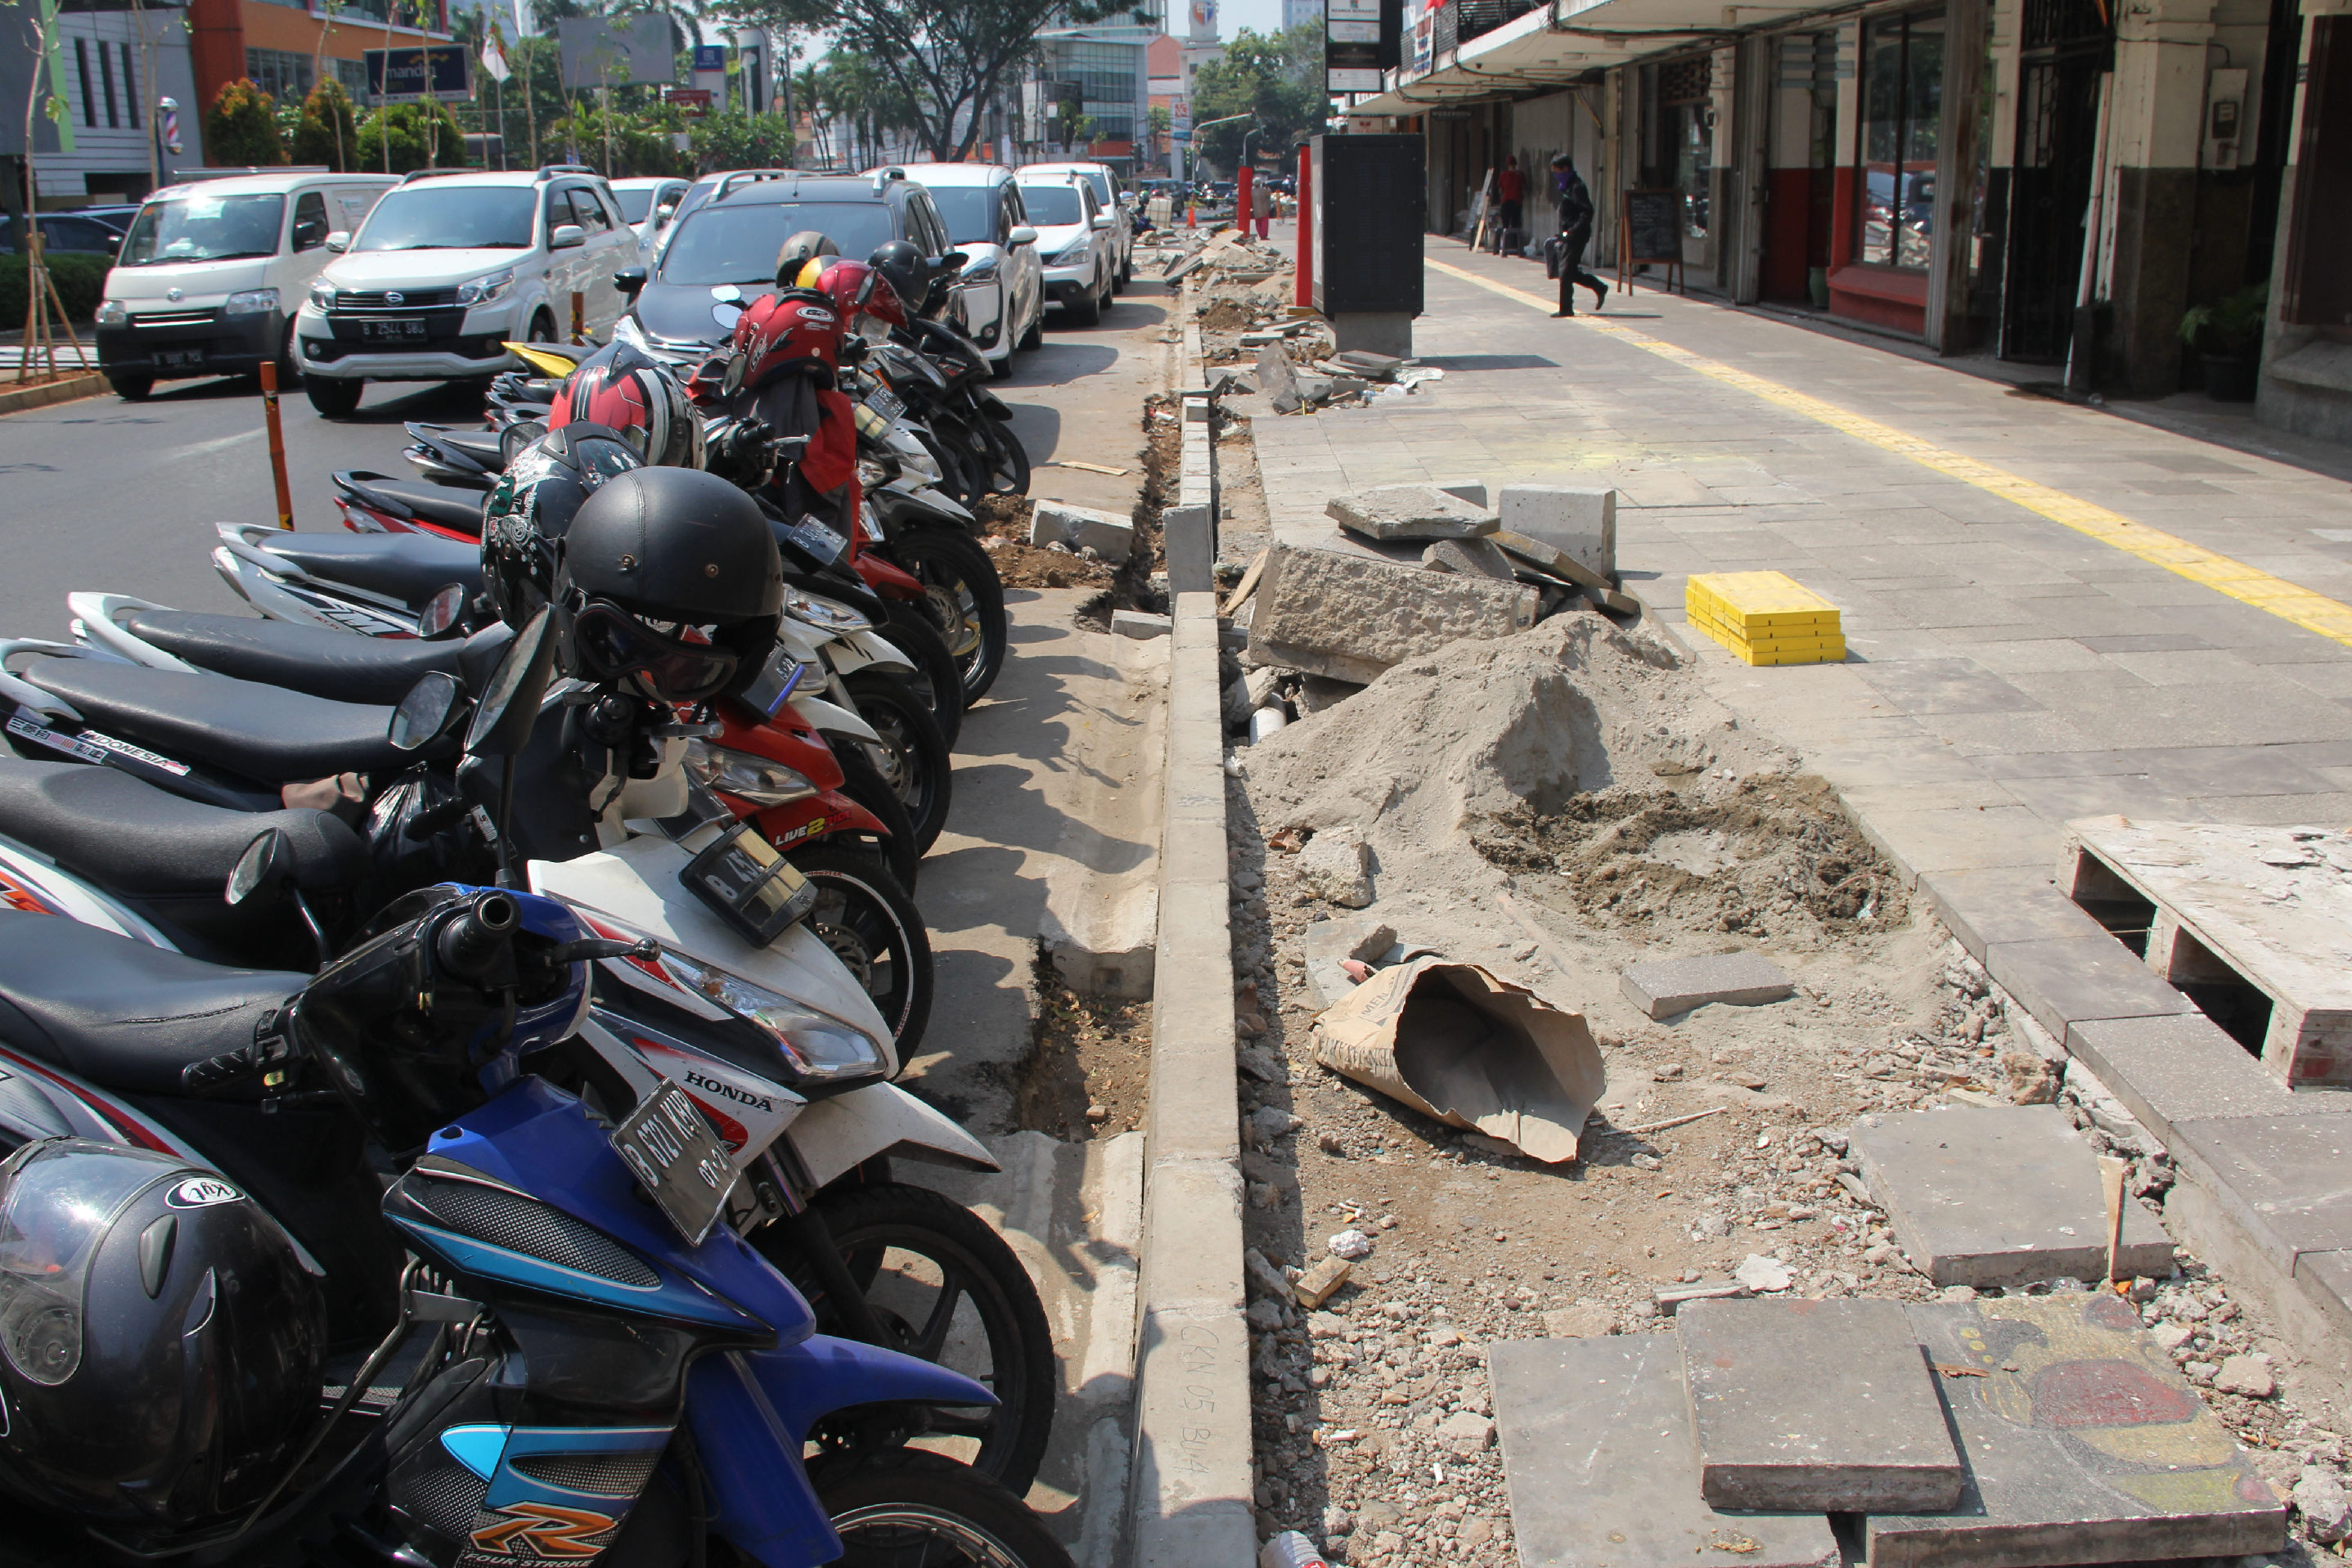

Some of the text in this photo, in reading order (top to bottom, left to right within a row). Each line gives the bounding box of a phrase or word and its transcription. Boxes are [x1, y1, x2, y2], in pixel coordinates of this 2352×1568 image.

[792, 536, 810, 549] B
[79, 731, 169, 766] INDONESIA
[704, 874, 740, 900] B
[684, 1070, 775, 1113] HONDA
[636, 1113, 684, 1170] 6721
[623, 1143, 659, 1188] B
[463, 1552, 595, 1568] FOUR STROKE
